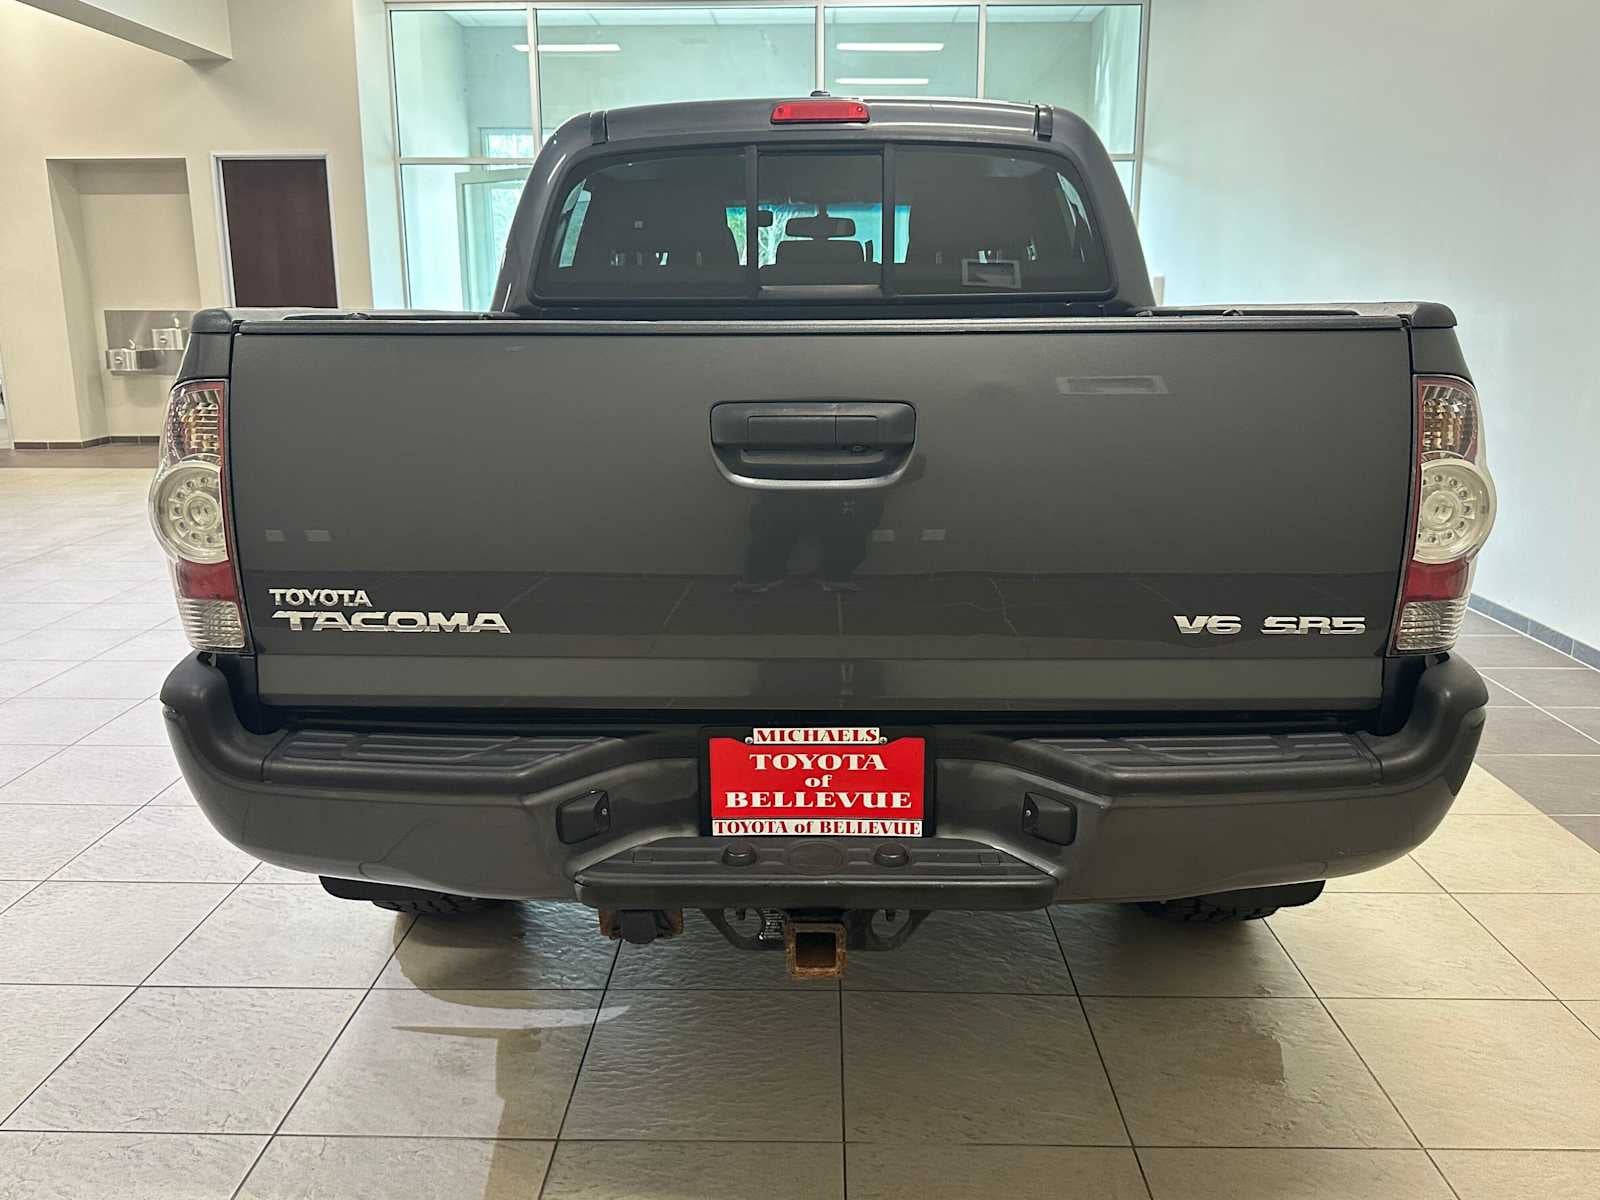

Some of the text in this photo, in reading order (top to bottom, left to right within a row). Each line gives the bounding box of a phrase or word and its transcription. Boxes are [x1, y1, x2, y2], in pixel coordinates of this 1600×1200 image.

[268, 588, 373, 607] TOYOTA
[271, 610, 511, 634] TACOMA
[1173, 615, 1366, 635] V6 SR5
[756, 729, 878, 743] MICHAELS
[749, 753, 888, 771] TOYOTA
[804, 774, 833, 788] of
[725, 791, 912, 809] BELLEVUE
[714, 820, 922, 836] TOYOTA of BELLEVUE
